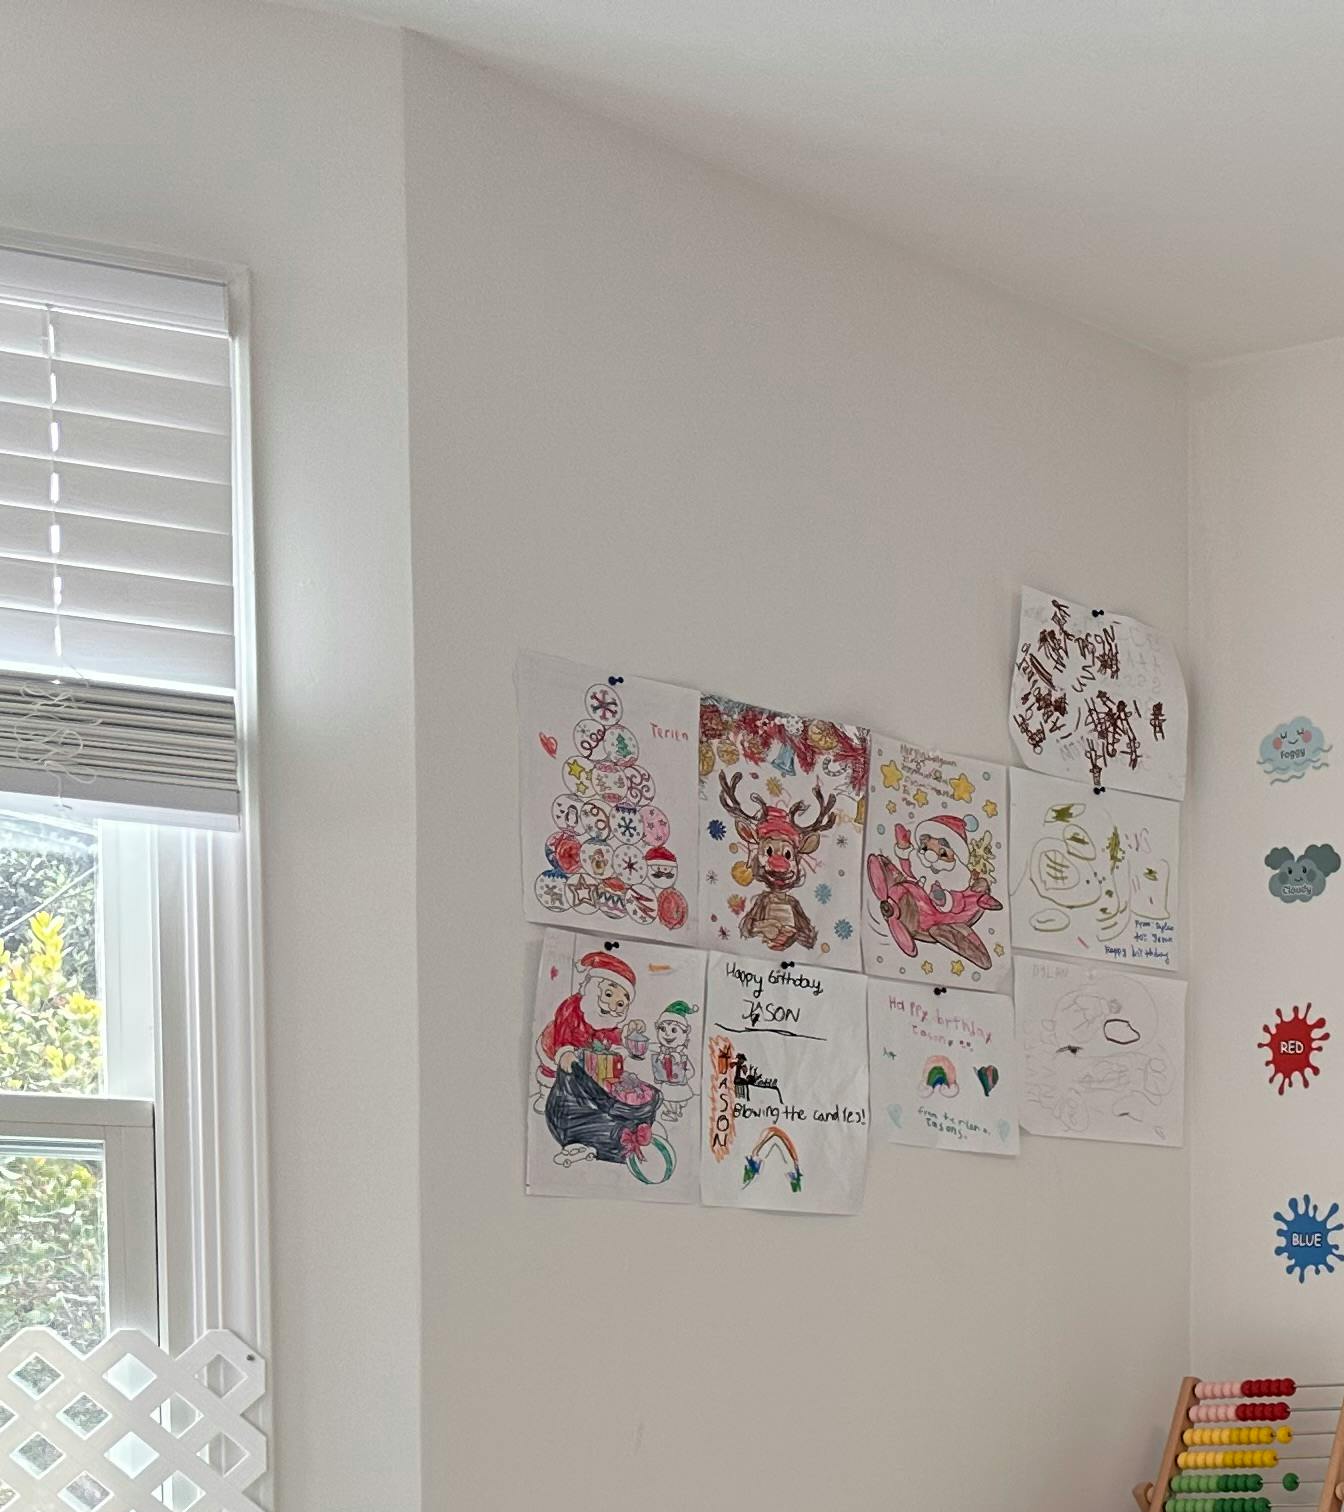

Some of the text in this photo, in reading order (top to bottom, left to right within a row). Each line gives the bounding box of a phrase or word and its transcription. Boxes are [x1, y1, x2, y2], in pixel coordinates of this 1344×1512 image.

[1282, 884, 1313, 897] Cloudy
[1280, 1041, 1304, 1055] RED
[1292, 1232, 1323, 1247] BLUE
